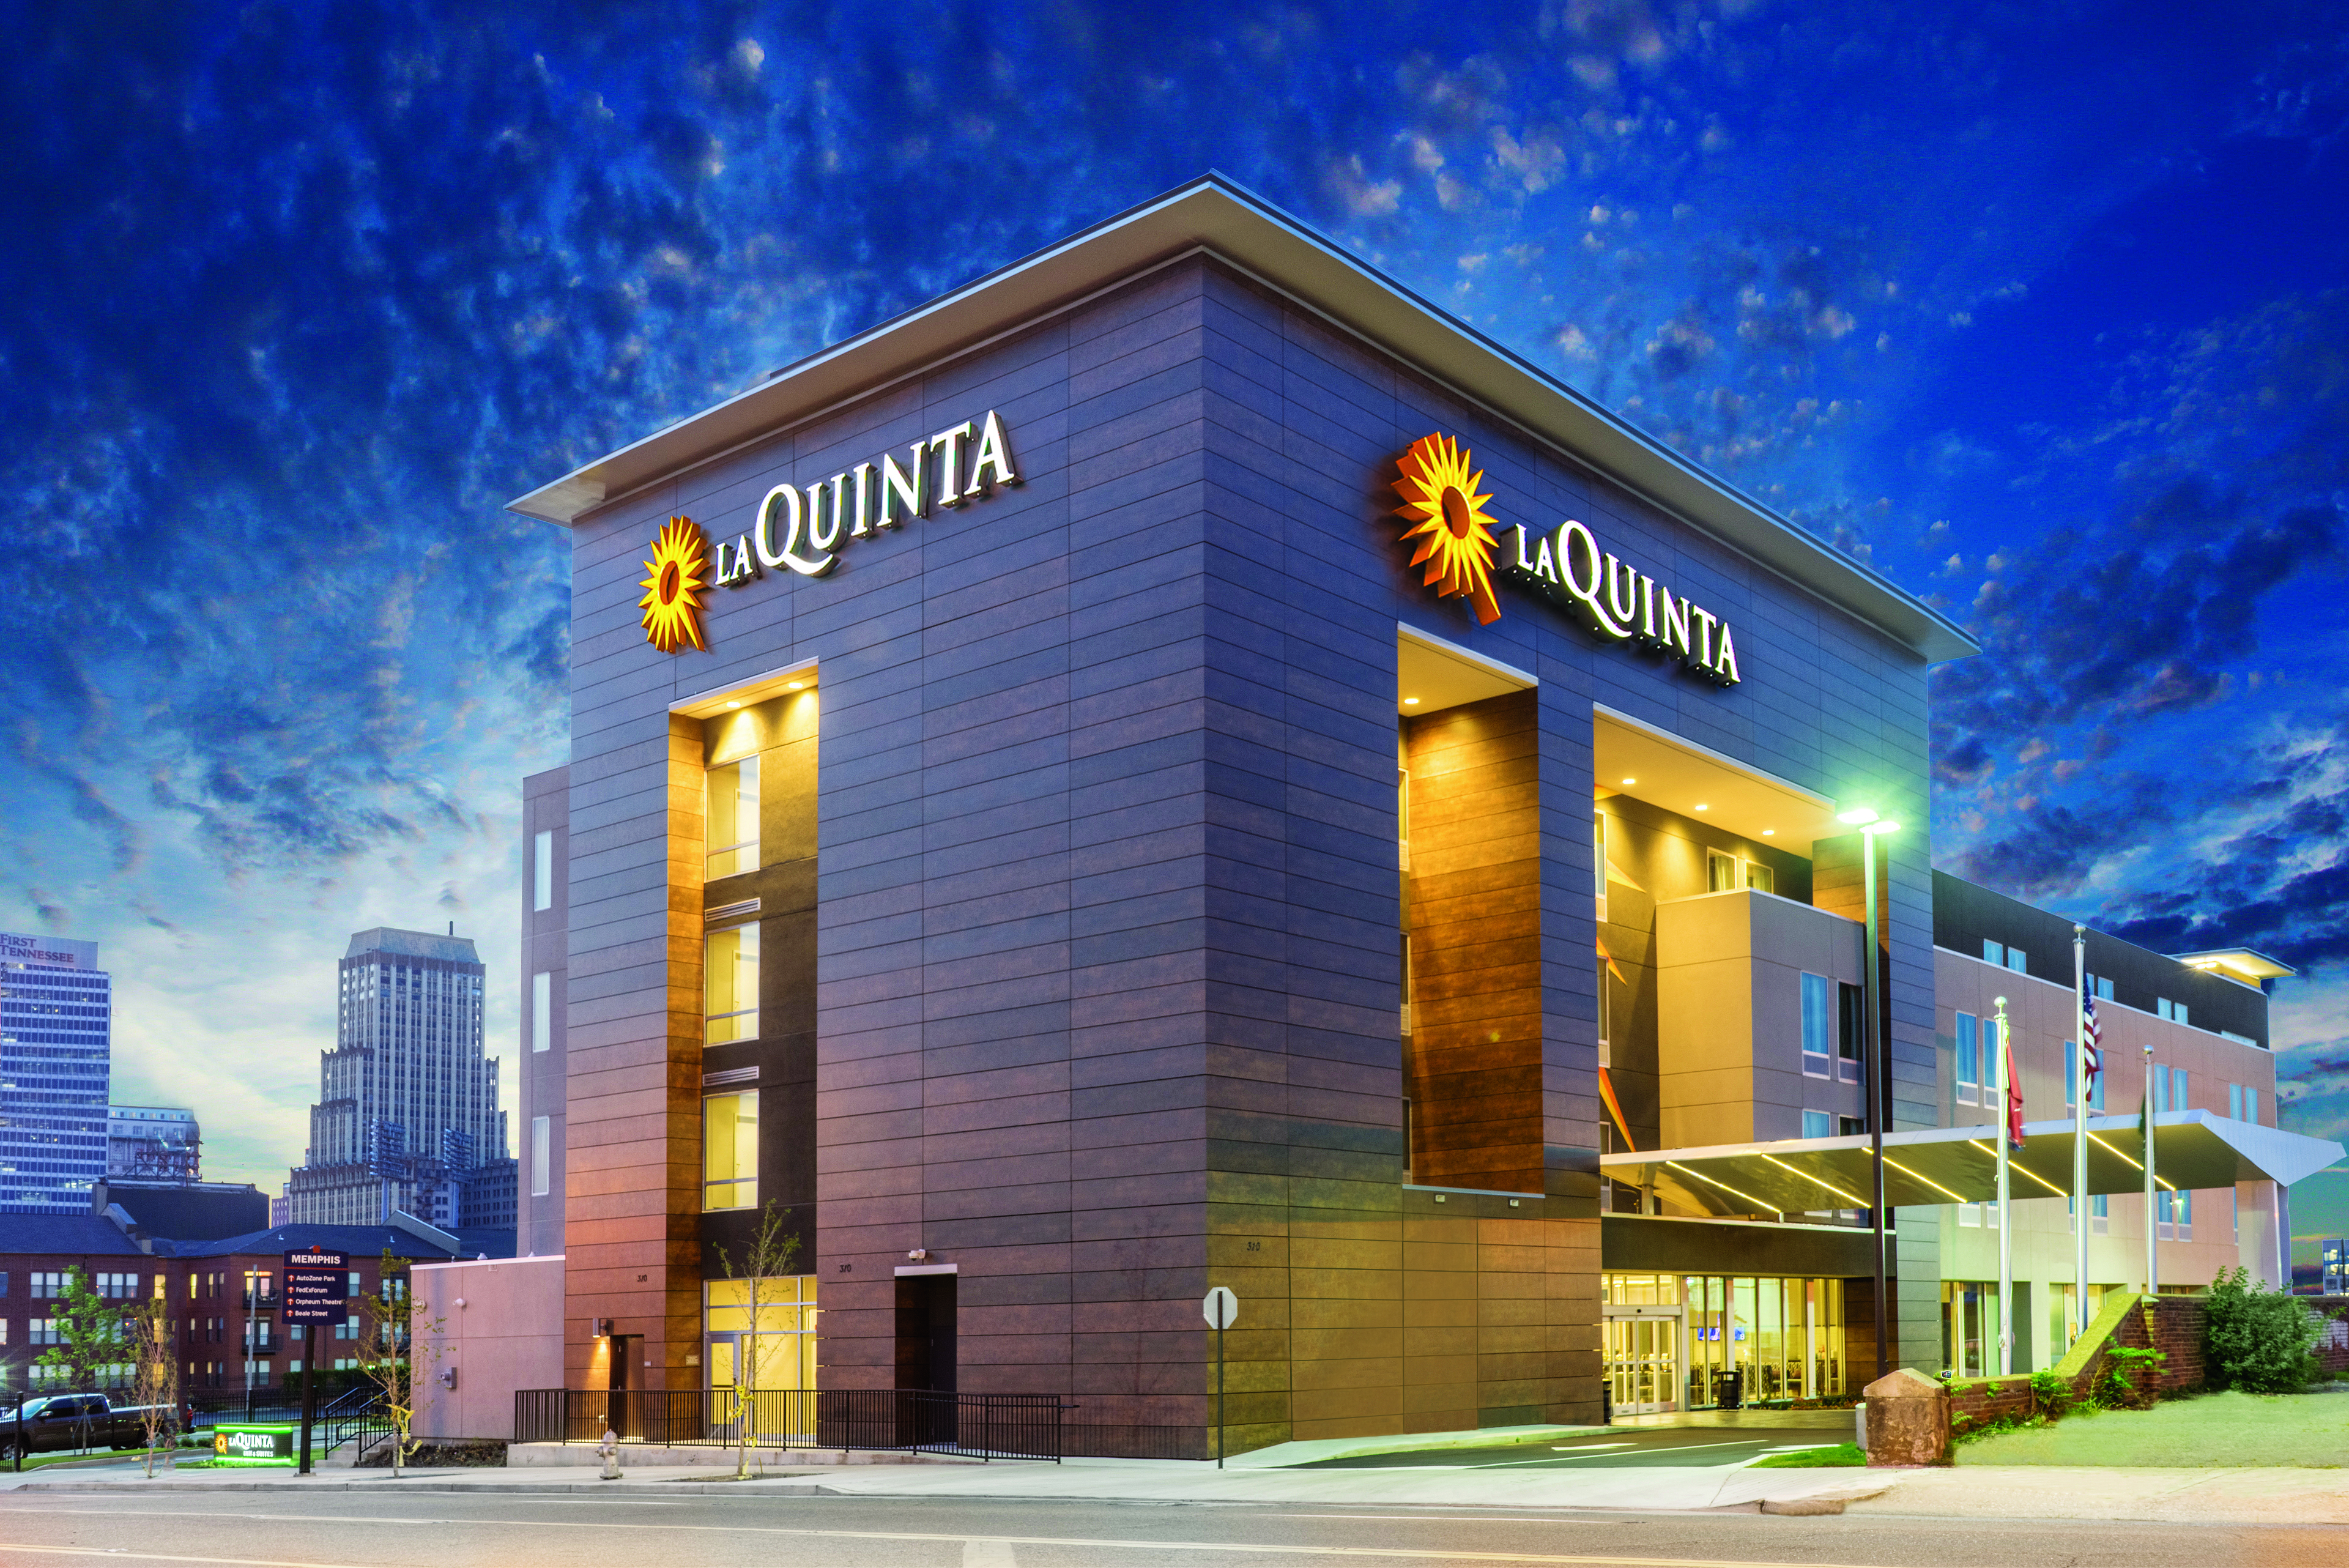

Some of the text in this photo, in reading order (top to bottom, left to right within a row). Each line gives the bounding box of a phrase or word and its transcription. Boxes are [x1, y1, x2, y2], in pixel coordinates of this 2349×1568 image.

[714, 409, 1020, 587] LA QUINTA
[1510, 519, 1742, 685] LA QUINTA
[0, 934, 37, 948] FIRST
[0, 945, 74, 963] TENNESSEE
[1247, 1241, 1260, 1251] 310
[291, 1254, 341, 1265] MEMPHIS
[839, 1264, 852, 1273] 310
[228, 1432, 275, 1451] LA QUINTA
